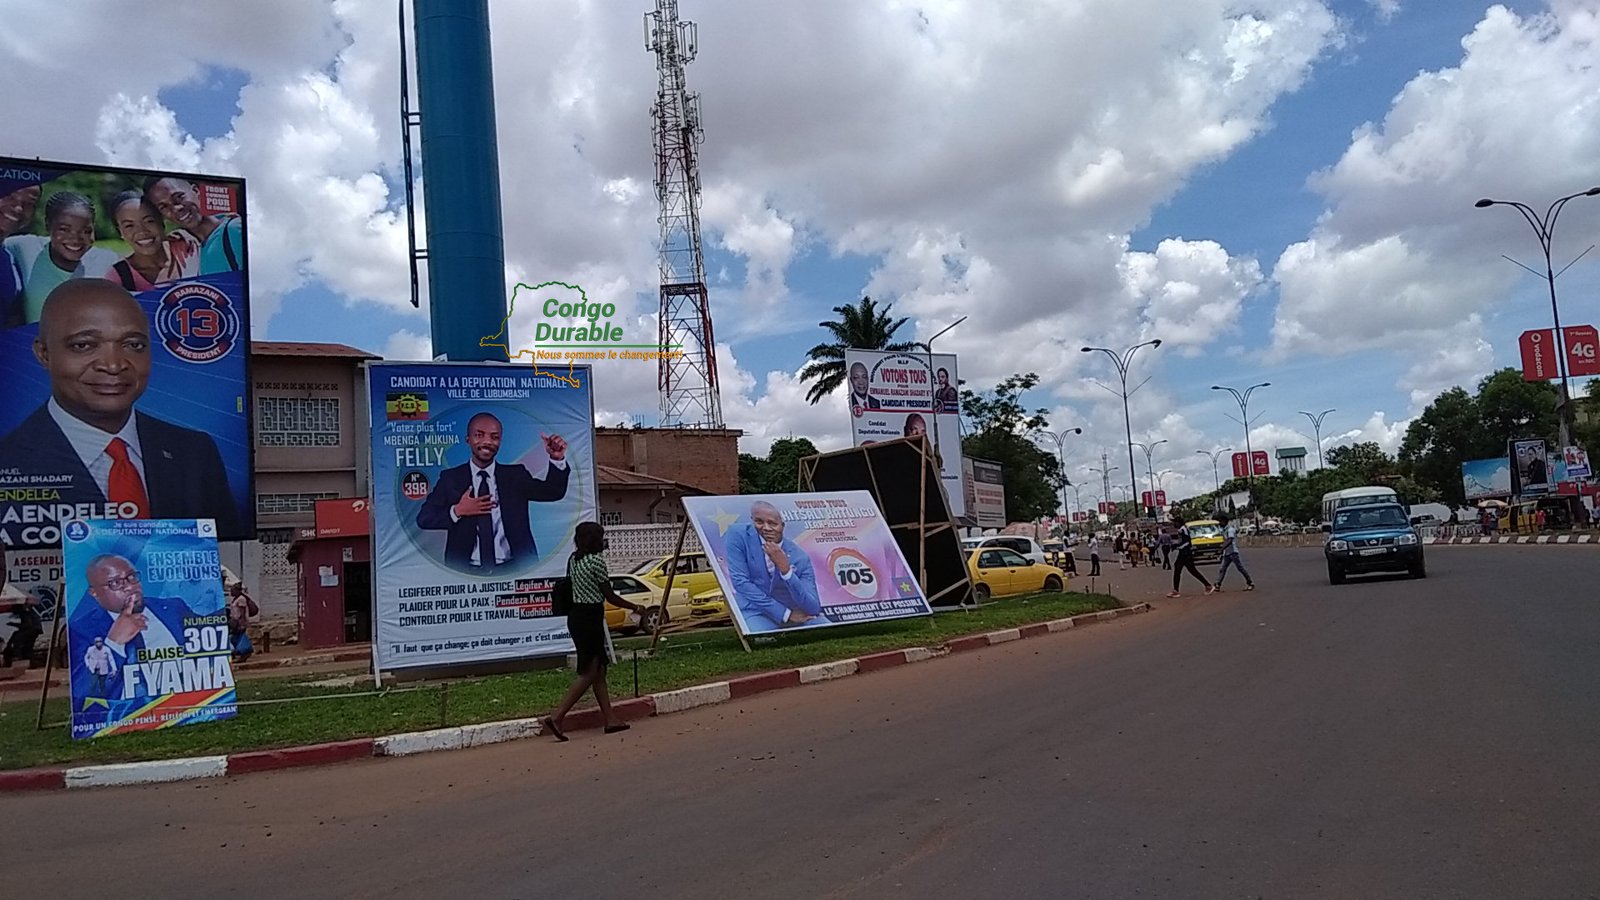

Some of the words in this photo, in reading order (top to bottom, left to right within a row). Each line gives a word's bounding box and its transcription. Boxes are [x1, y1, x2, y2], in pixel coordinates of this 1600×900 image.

[0, 168, 41, 181] ATION
[206, 198, 230, 206] POUR
[174, 286, 220, 300] RAMAZANI
[176, 308, 219, 337] 13
[176, 345, 222, 360] PRESIDENT
[1571, 342, 1596, 358] 4G
[1534, 343, 1543, 377] vodacom
[390, 376, 437, 388] CANDIDAT
[439, 376, 446, 388] A
[448, 377, 460, 388] LA
[461, 377, 517, 388] DEPUTATION
[520, 378, 568, 389] NATIONALE
[880, 367, 909, 384] VOTONS
[908, 369, 927, 385] TOUS
[447, 388, 467, 398] VILLE
[470, 389, 481, 398] DE
[484, 389, 530, 398] LUBUMBASHI
[881, 399, 906, 407] CANDIDAT
[906, 400, 931, 408] PRESIDENT
[853, 407, 862, 416] 13
[416, 422, 434, 435] plus
[383, 435, 420, 446] MBENGA
[424, 434, 460, 445] MUKUNA
[395, 446, 444, 467] FELLY
[1254, 457, 1266, 466] 4G
[30, 474, 74, 483] SHADARY
[0, 489, 61, 501] ENDELEA
[404, 481, 428, 496] 398
[1, 501, 139, 523] AENDELEO
[21, 525, 61, 545] CO
[102, 527, 152, 536] DEPUTATION
[147, 551, 219, 568] ENSEMBLE
[8, 569, 41, 583] LES
[148, 564, 221, 583] EVOLUONS
[838, 568, 874, 586] 105
[399, 586, 441, 598] LEGIFERER
[443, 584, 465, 595] POUR
[467, 583, 478, 593] LA
[479, 581, 514, 592] JUSTICE:
[515, 580, 543, 592] Légifer
[399, 600, 433, 613] PLAIDER
[435, 599, 457, 610] POUR
[459, 598, 470, 609] LA
[471, 597, 490, 608] PAIX
[497, 596, 528, 607] Pendeza
[530, 594, 546, 603] Kwa
[824, 606, 834, 616] LE
[834, 602, 880, 614] CHANGEMENT
[880, 600, 893, 610] EST
[184, 615, 227, 626] NUMERO
[399, 614, 447, 627] CONTROLER
[449, 612, 472, 623] POUR
[473, 611, 483, 621] LE
[484, 608, 519, 620] TRAVAIL:
[183, 625, 230, 655] 307
[403, 643, 418, 653] faut
[420, 644, 433, 653] que
[434, 643, 443, 652] ça
[471, 640, 480, 649] ça
[480, 637, 494, 647] doit
[494, 636, 520, 646] changer
[525, 634, 533, 643] et
[535, 633, 551, 642] c'est
[138, 646, 184, 662] BLAISE
[123, 655, 235, 700] FYAMA
[73, 723, 94, 733] POUR
[95, 721, 106, 730] UN
[108, 718, 133, 728] CONGO
